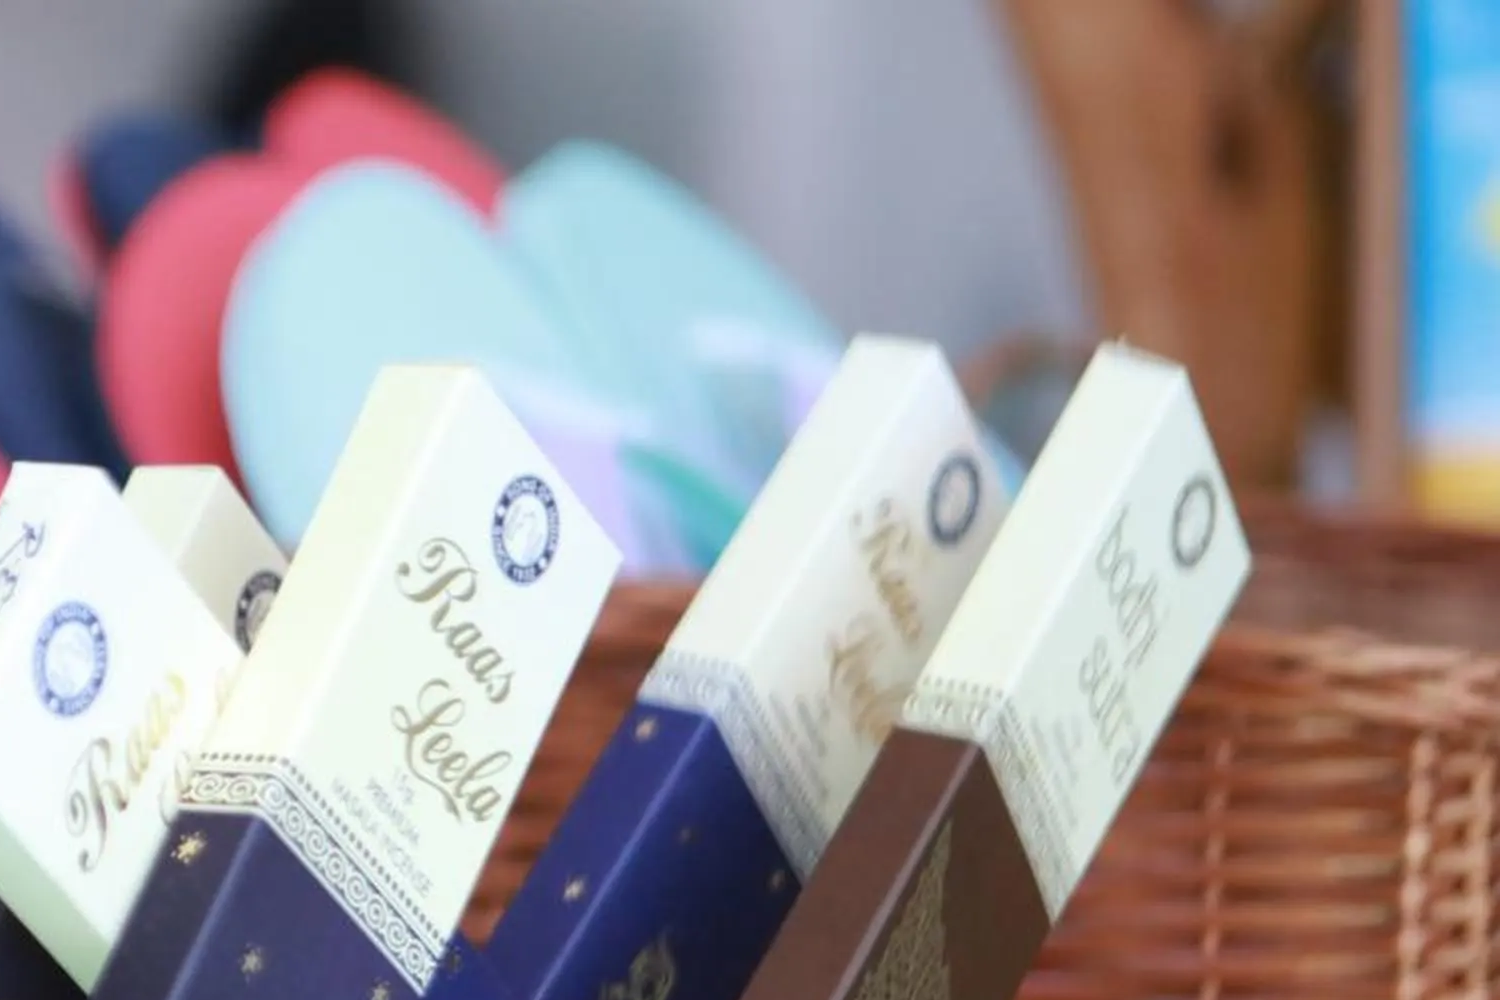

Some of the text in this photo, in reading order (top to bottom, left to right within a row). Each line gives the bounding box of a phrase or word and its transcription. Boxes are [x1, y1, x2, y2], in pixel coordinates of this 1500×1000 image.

[395, 537, 516, 704] Raas
[1096, 502, 1168, 670] bodhi
[63, 668, 188, 875] Raas
[390, 677, 513, 826] Leela
[1078, 636, 1143, 788] sutra
